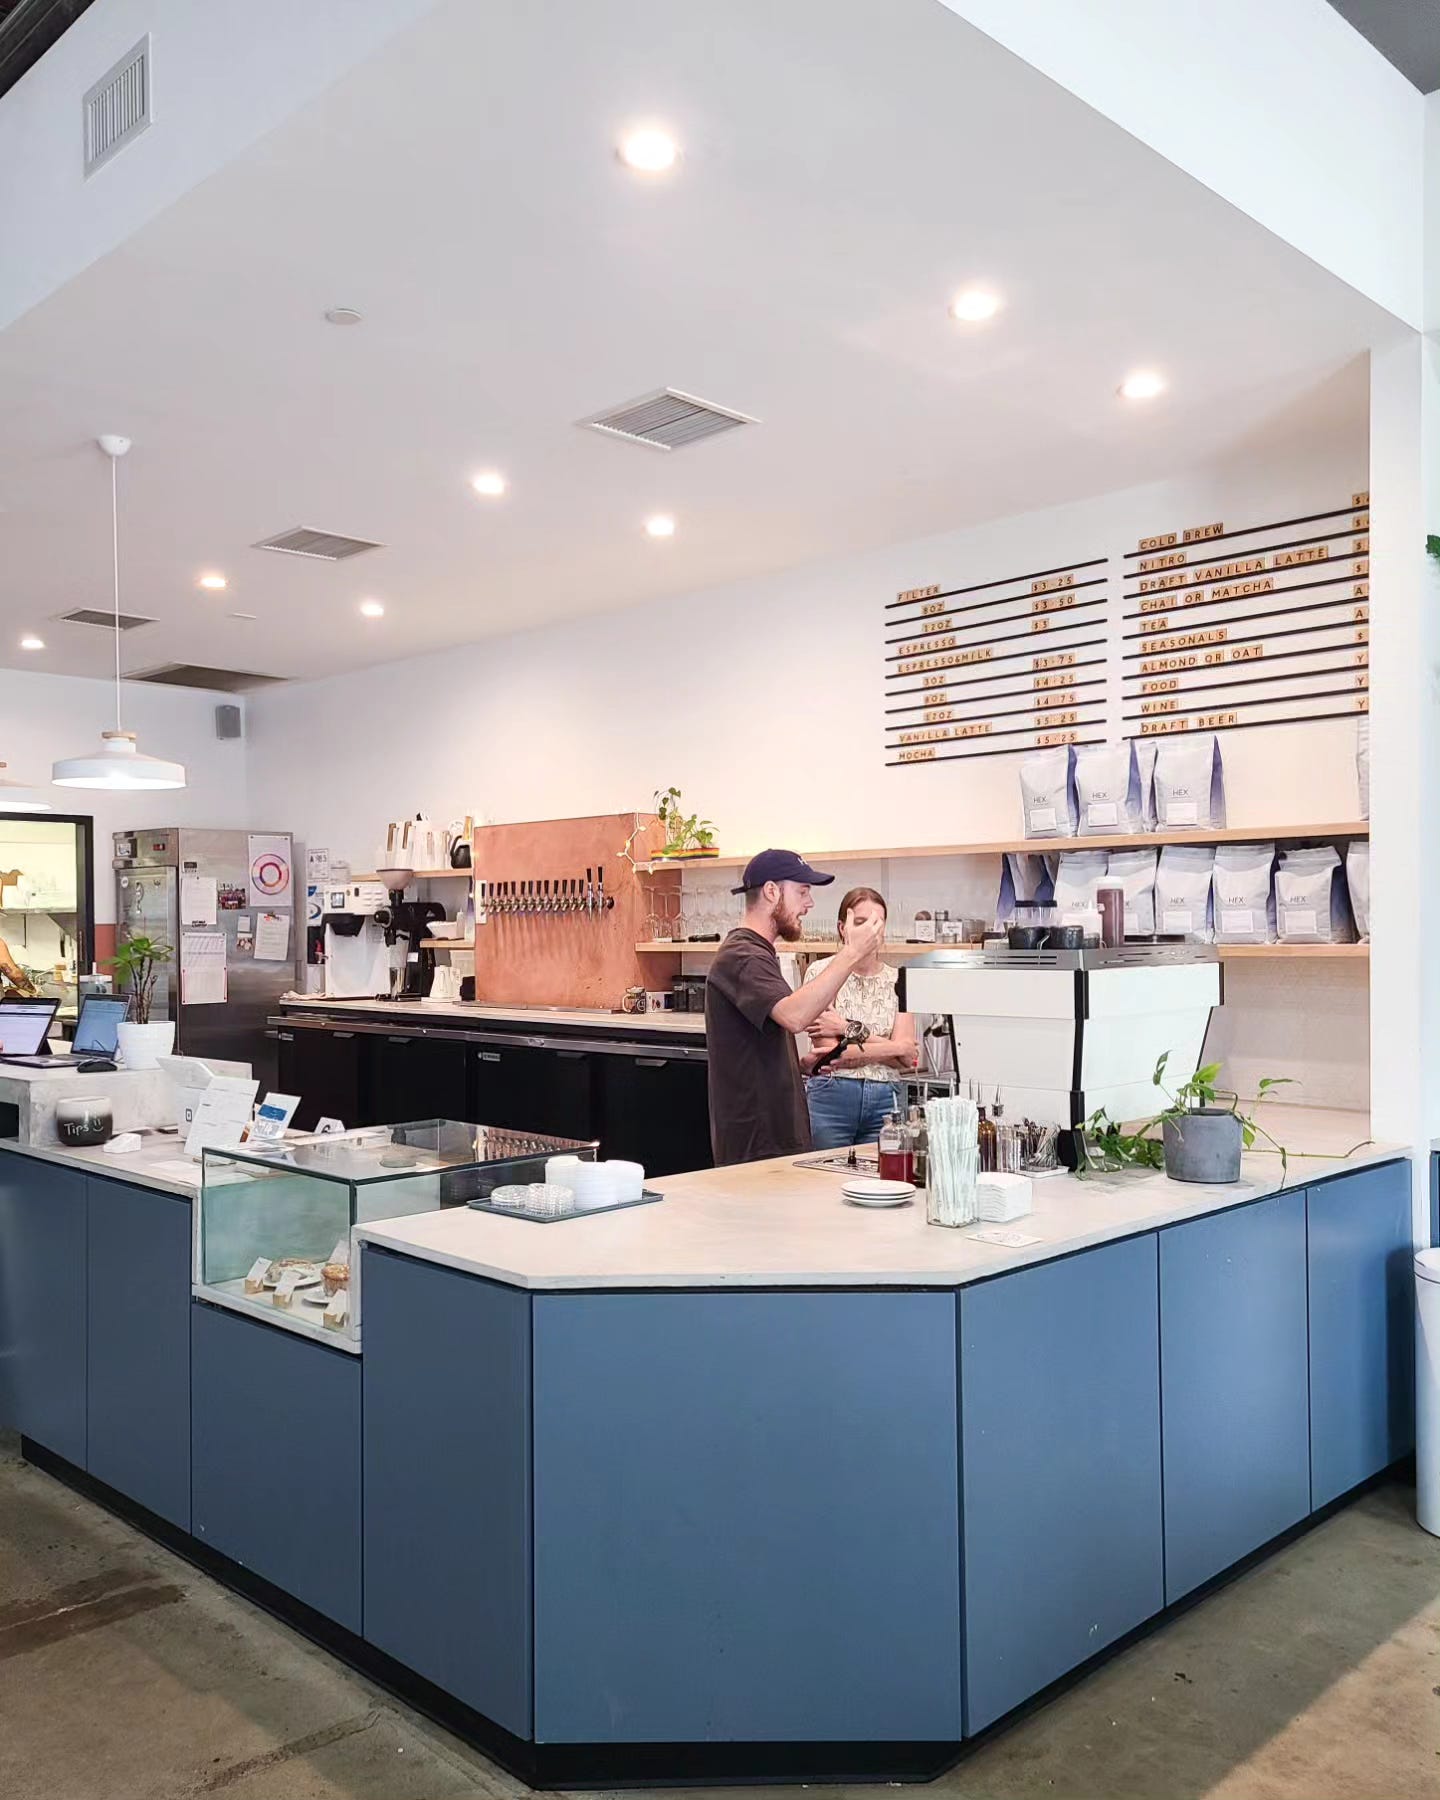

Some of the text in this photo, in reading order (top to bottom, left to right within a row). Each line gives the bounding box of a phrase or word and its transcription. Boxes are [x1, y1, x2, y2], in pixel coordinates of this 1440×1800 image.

[1140, 535, 1175, 550] COLD
[1185, 525, 1222, 541] BREW
[1140, 554, 1185, 571] NITRO
[1140, 575, 1184, 591] DRAFT
[1195, 561, 1263, 580] VANILLA
[1275, 548, 1325, 566] LATTE
[898, 585, 940, 601] FILTER
[1141, 598, 1174, 611] CHAI
[1184, 593, 1201, 604] OR
[1212, 580, 1271, 599] MATCHA
[1141, 620, 1167, 631] TEA
[898, 638, 956, 655] ESPRESSO
[1141, 631, 1224, 652] SEASONALS
[1141, 657, 1196, 672] ALMOND
[1205, 653, 1222, 663] OR
[1232, 647, 1259, 659] OAT
[1142, 680, 1177, 691] FOOD
[1141, 700, 1176, 713] WINE
[1141, 719, 1185, 733] DRAFT
[1198, 714, 1234, 727] BEER
[899, 729, 949, 742] VANILLA
[954, 724, 991, 736] LATTE
[899, 749, 933, 760] MOCHA
[1033, 795, 1047, 803] HEX
[1092, 791, 1107, 799] HEX
[1172, 788, 1189, 797] HEX
[63, 1122, 89, 1136] Tips
